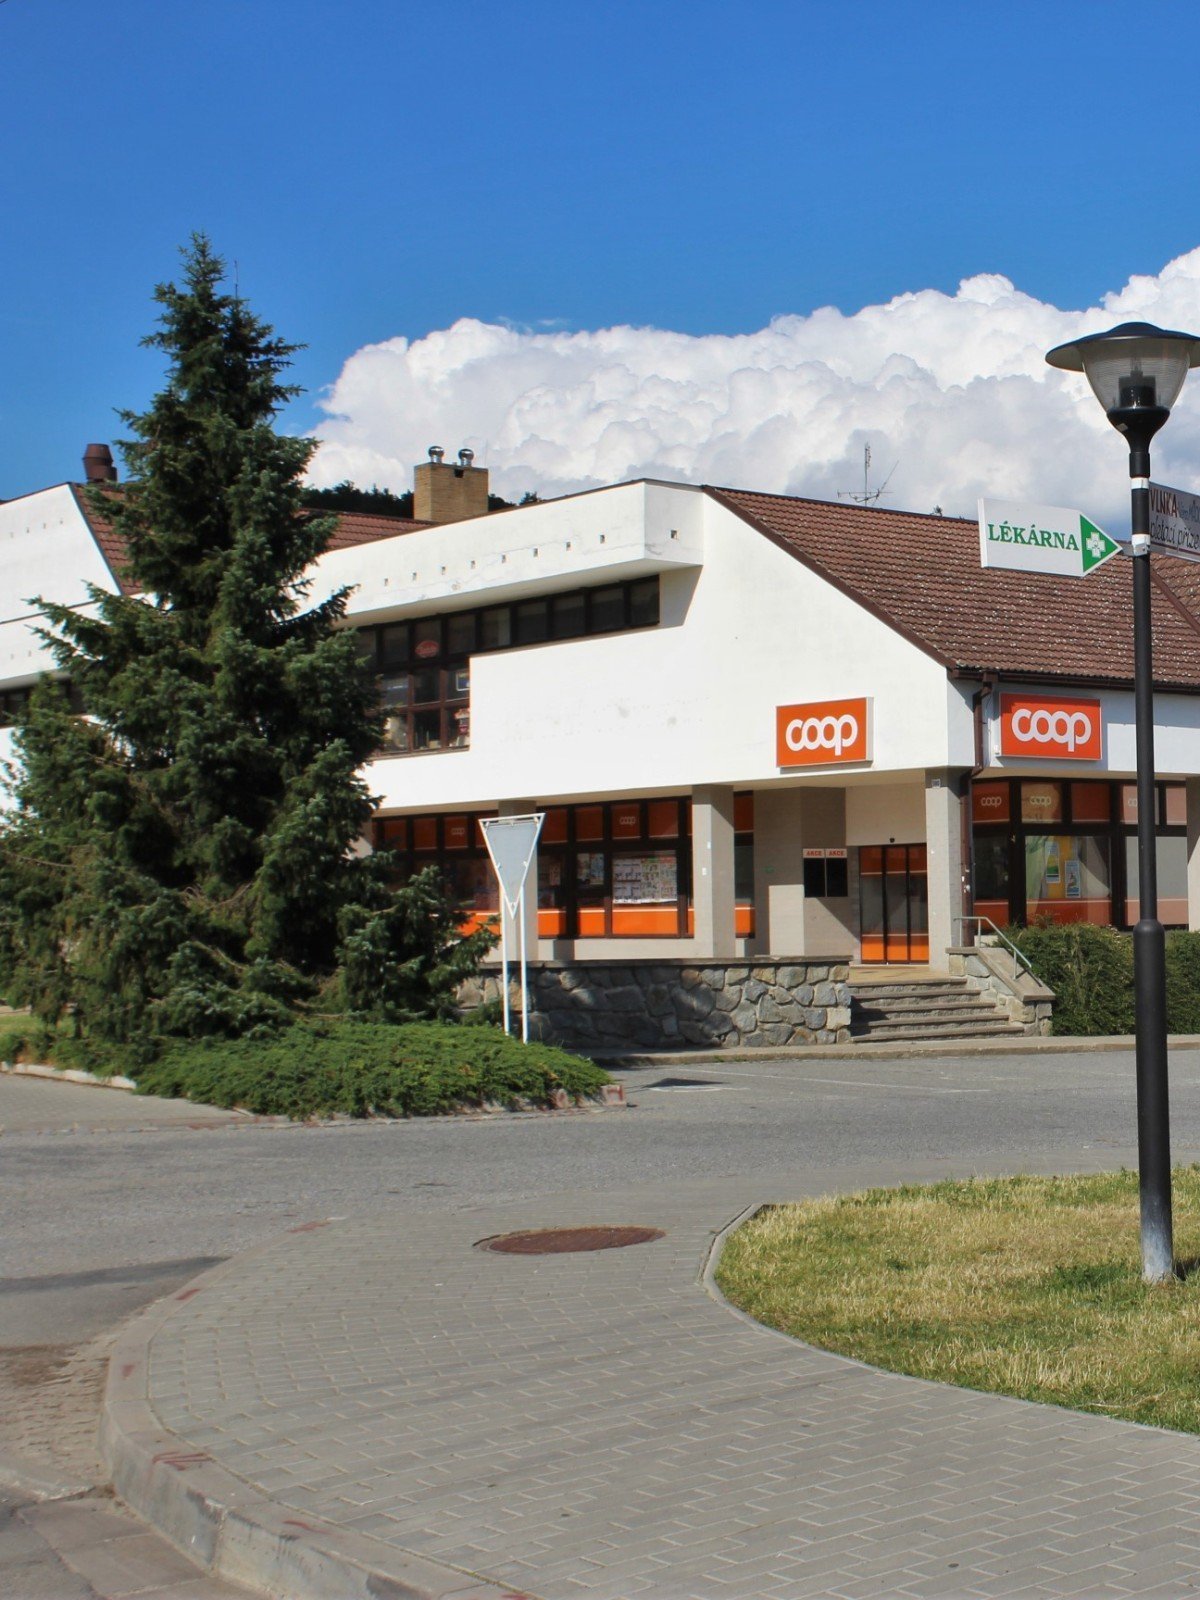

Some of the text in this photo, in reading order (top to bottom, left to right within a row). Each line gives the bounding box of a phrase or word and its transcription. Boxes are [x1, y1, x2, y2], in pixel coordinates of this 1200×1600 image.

[987, 520, 1080, 551] LÉKÁRNA
[785, 714, 859, 756] coop
[1011, 708, 1092, 753] coop
[981, 796, 1002, 807] coop
[1029, 796, 1051, 807] coop
